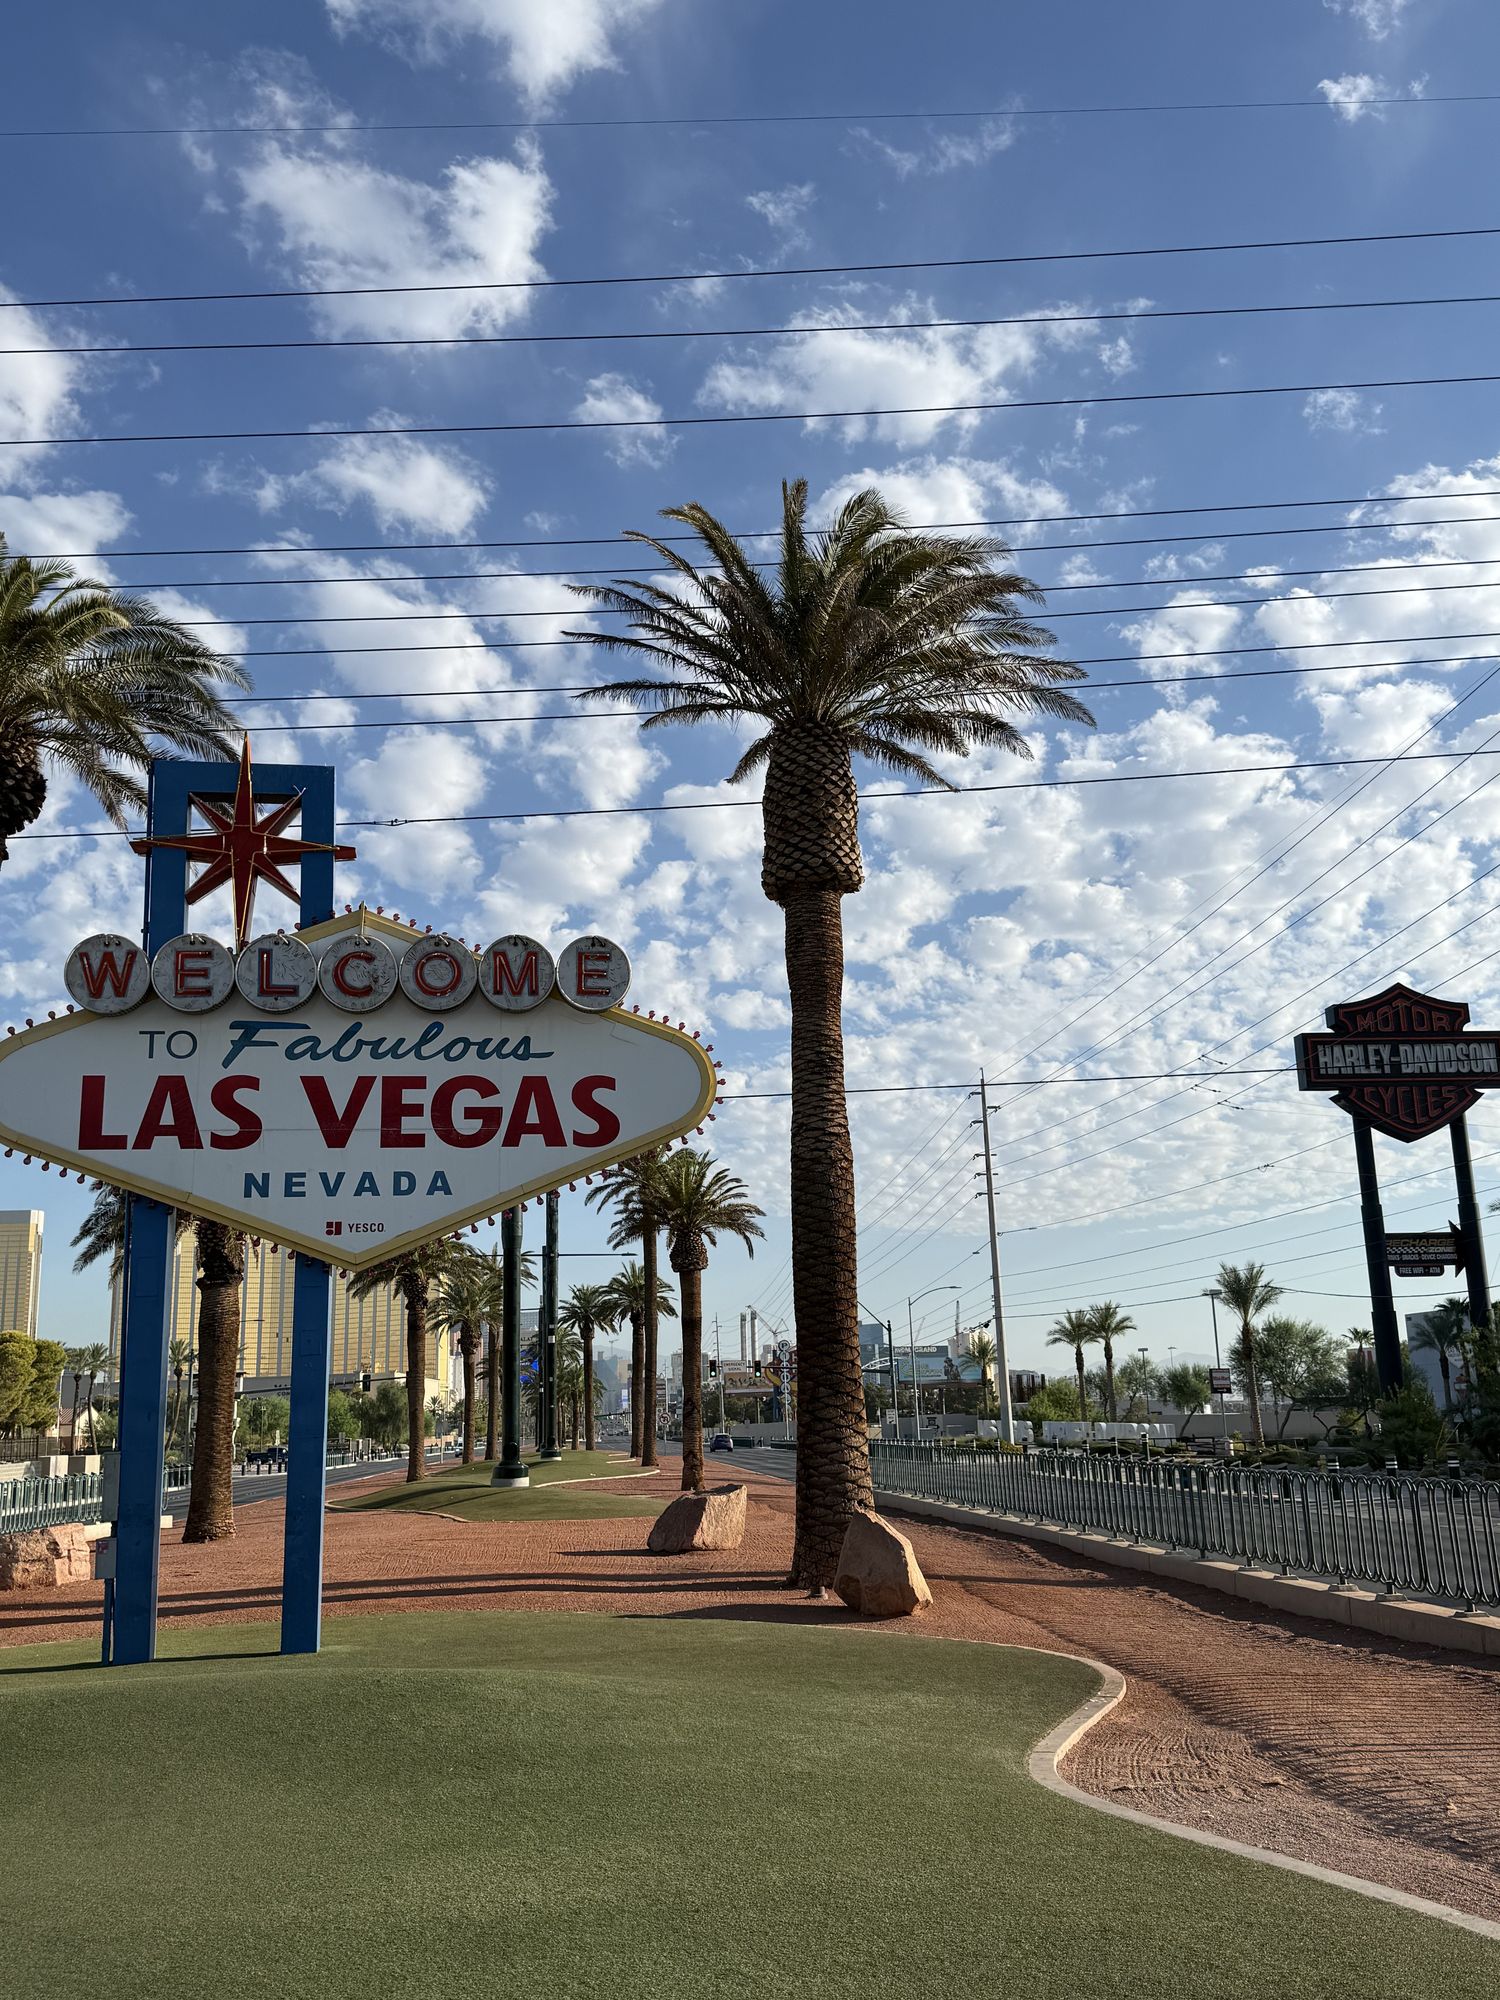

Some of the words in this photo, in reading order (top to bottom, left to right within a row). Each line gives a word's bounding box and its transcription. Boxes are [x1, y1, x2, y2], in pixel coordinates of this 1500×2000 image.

[79, 948, 612, 999] WELCOME
[1356, 998, 1451, 1032] MOTOR
[138, 1030, 199, 1060] TO
[221, 1020, 554, 1070] Fabulous
[1317, 1043, 1499, 1075] HARLEY-DAVIDSON
[78, 1074, 264, 1151] LAS
[299, 1074, 621, 1149] VEGAS
[1364, 1085, 1459, 1124] CYCLES
[243, 1170, 454, 1199] NEVADA
[347, 1222, 385, 1233] YESCO
[1386, 1238, 1455, 1247] RECHARGE
